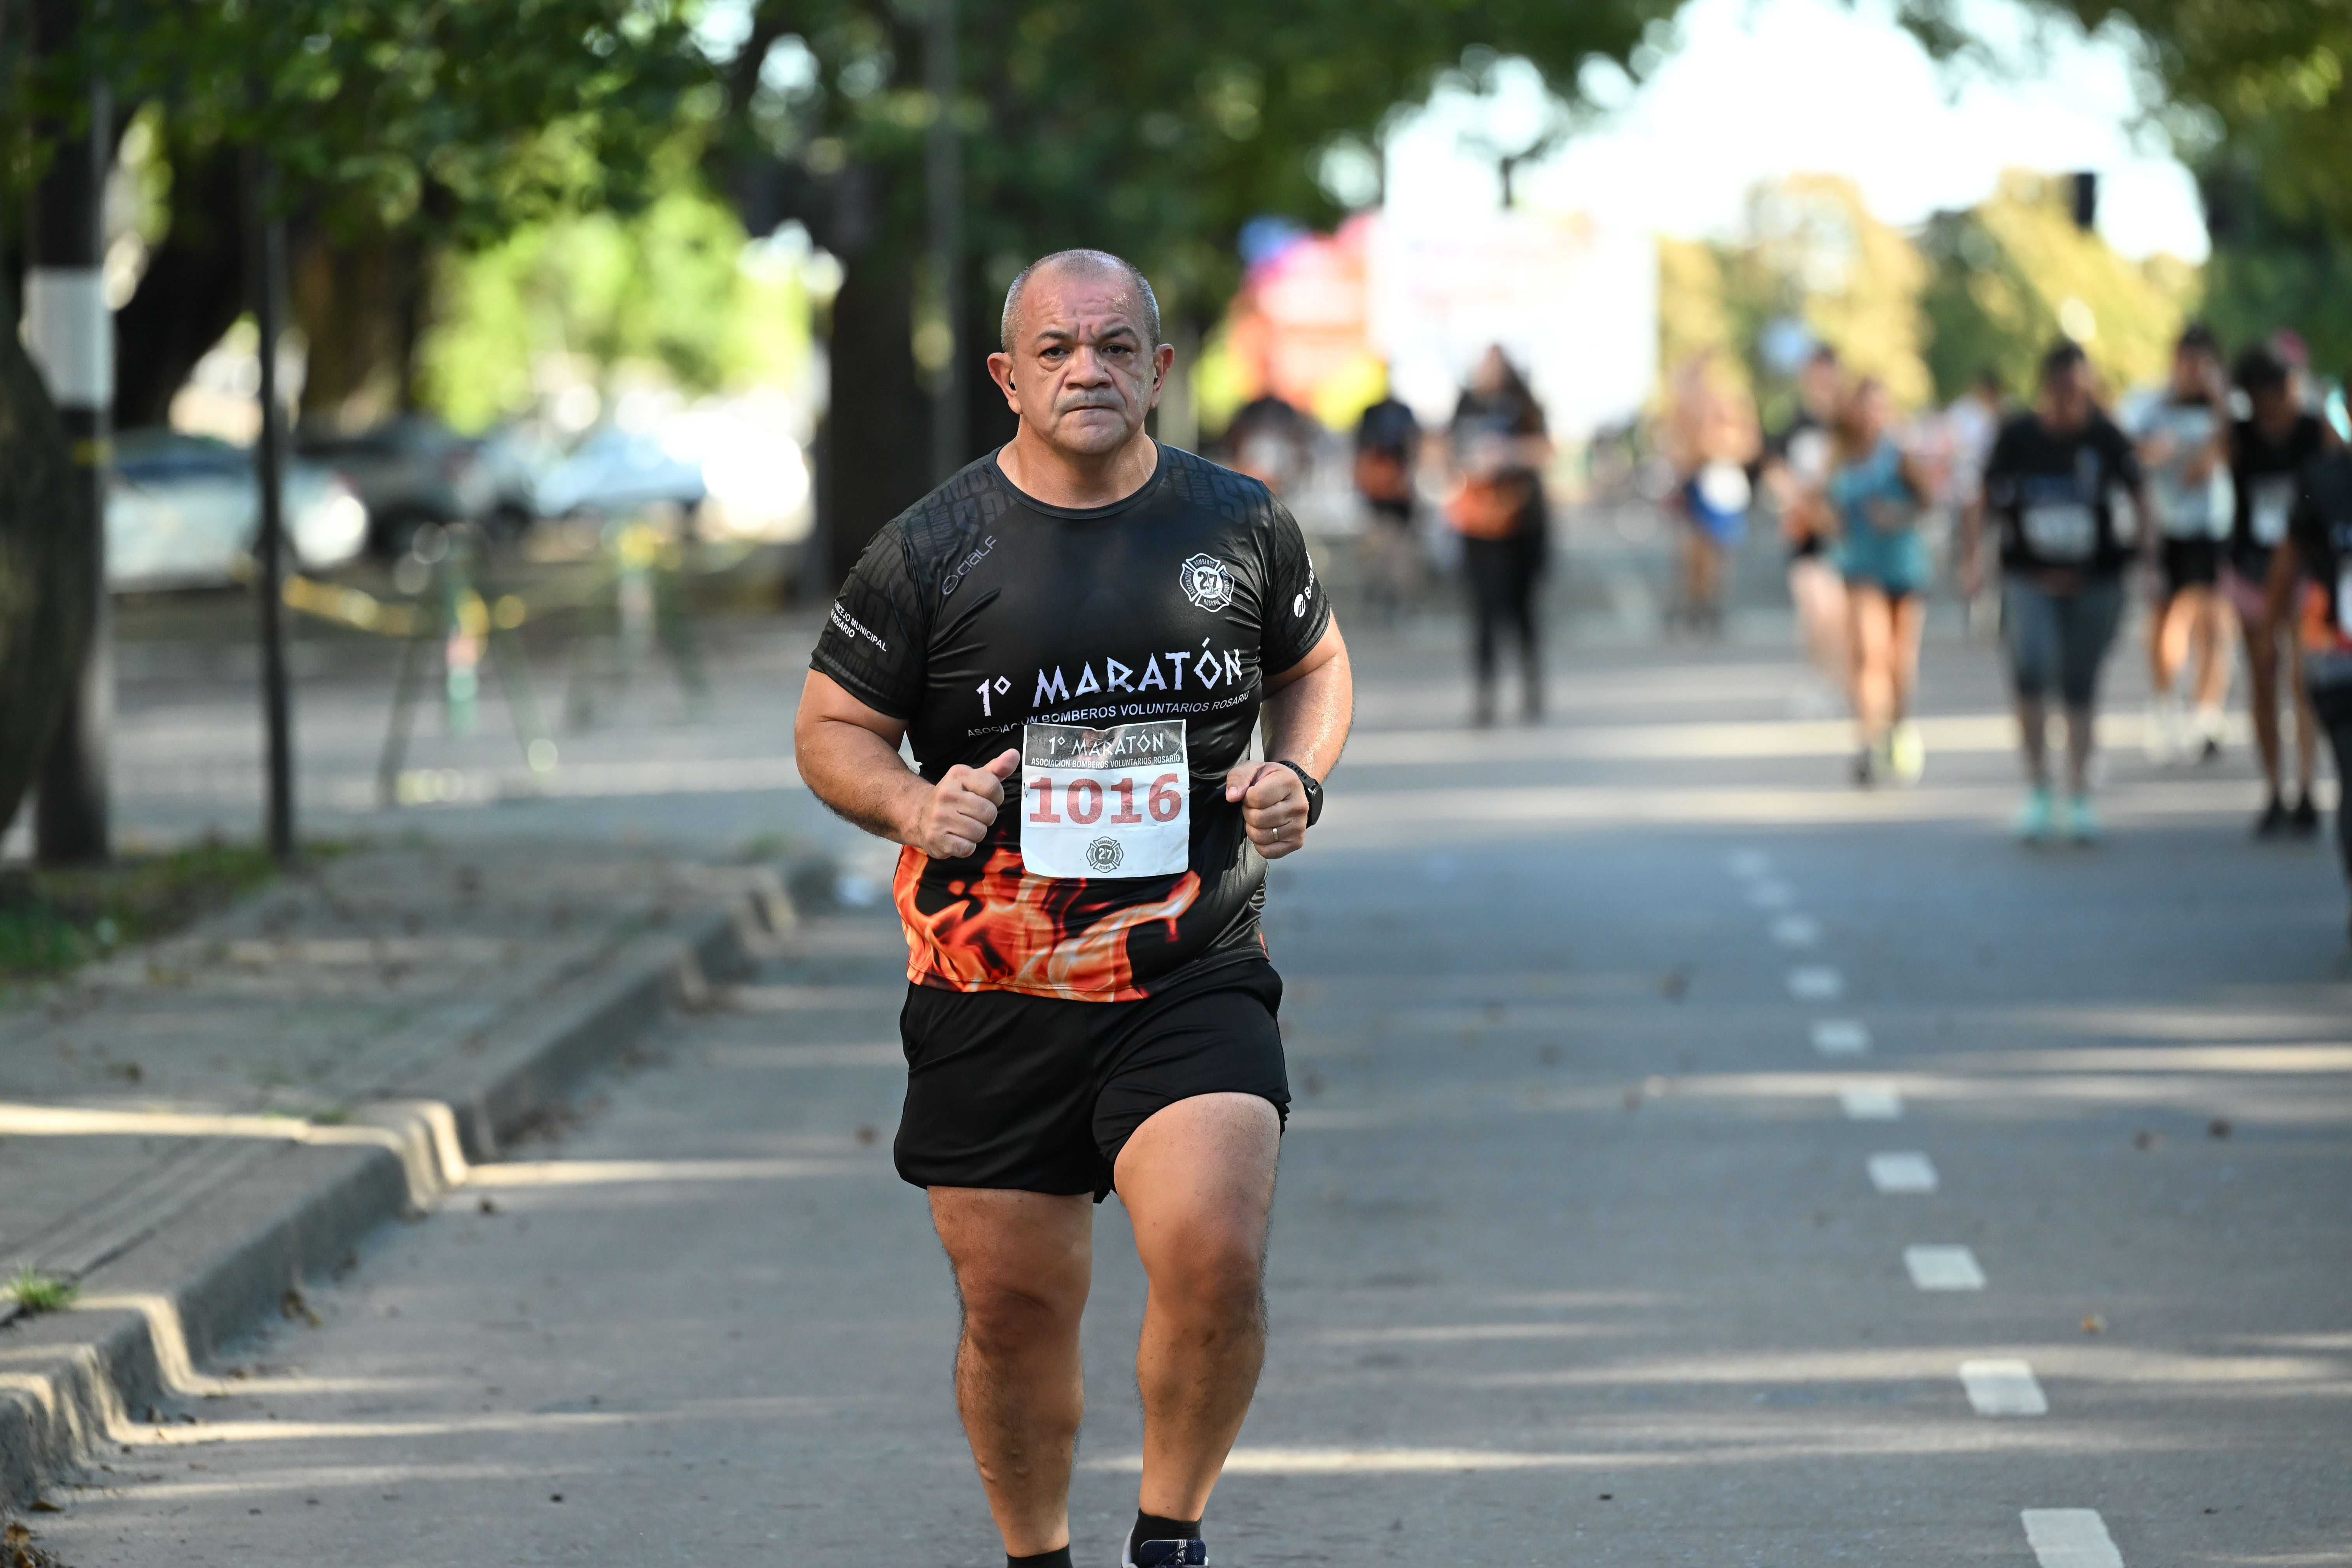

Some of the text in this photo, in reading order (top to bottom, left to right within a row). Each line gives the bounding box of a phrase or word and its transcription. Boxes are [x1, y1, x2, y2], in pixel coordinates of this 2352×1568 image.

[1193, 558, 1214, 567] BOMBEROS
[1197, 571, 1218, 590] 27
[1203, 598, 1220, 607] ROSARIO
[832, 613, 855, 638] ROSARIO
[850, 618, 887, 652] MUNICIPAL
[1032, 637, 1242, 707] MARATÓN
[1041, 705, 1116, 723] BOMBEROS
[1120, 702, 1209, 716] VOLUNTARIOS
[1211, 690, 1250, 710] ROSARIO
[1071, 729, 1163, 756] MARATÓN
[1072, 760, 1108, 768] BOMBEROS
[1110, 758, 1152, 768] VOLUNTARIOS
[1153, 754, 1180, 764] ROSARIO
[1029, 773, 1182, 825] 1016
[1098, 847, 1112, 860] 27
